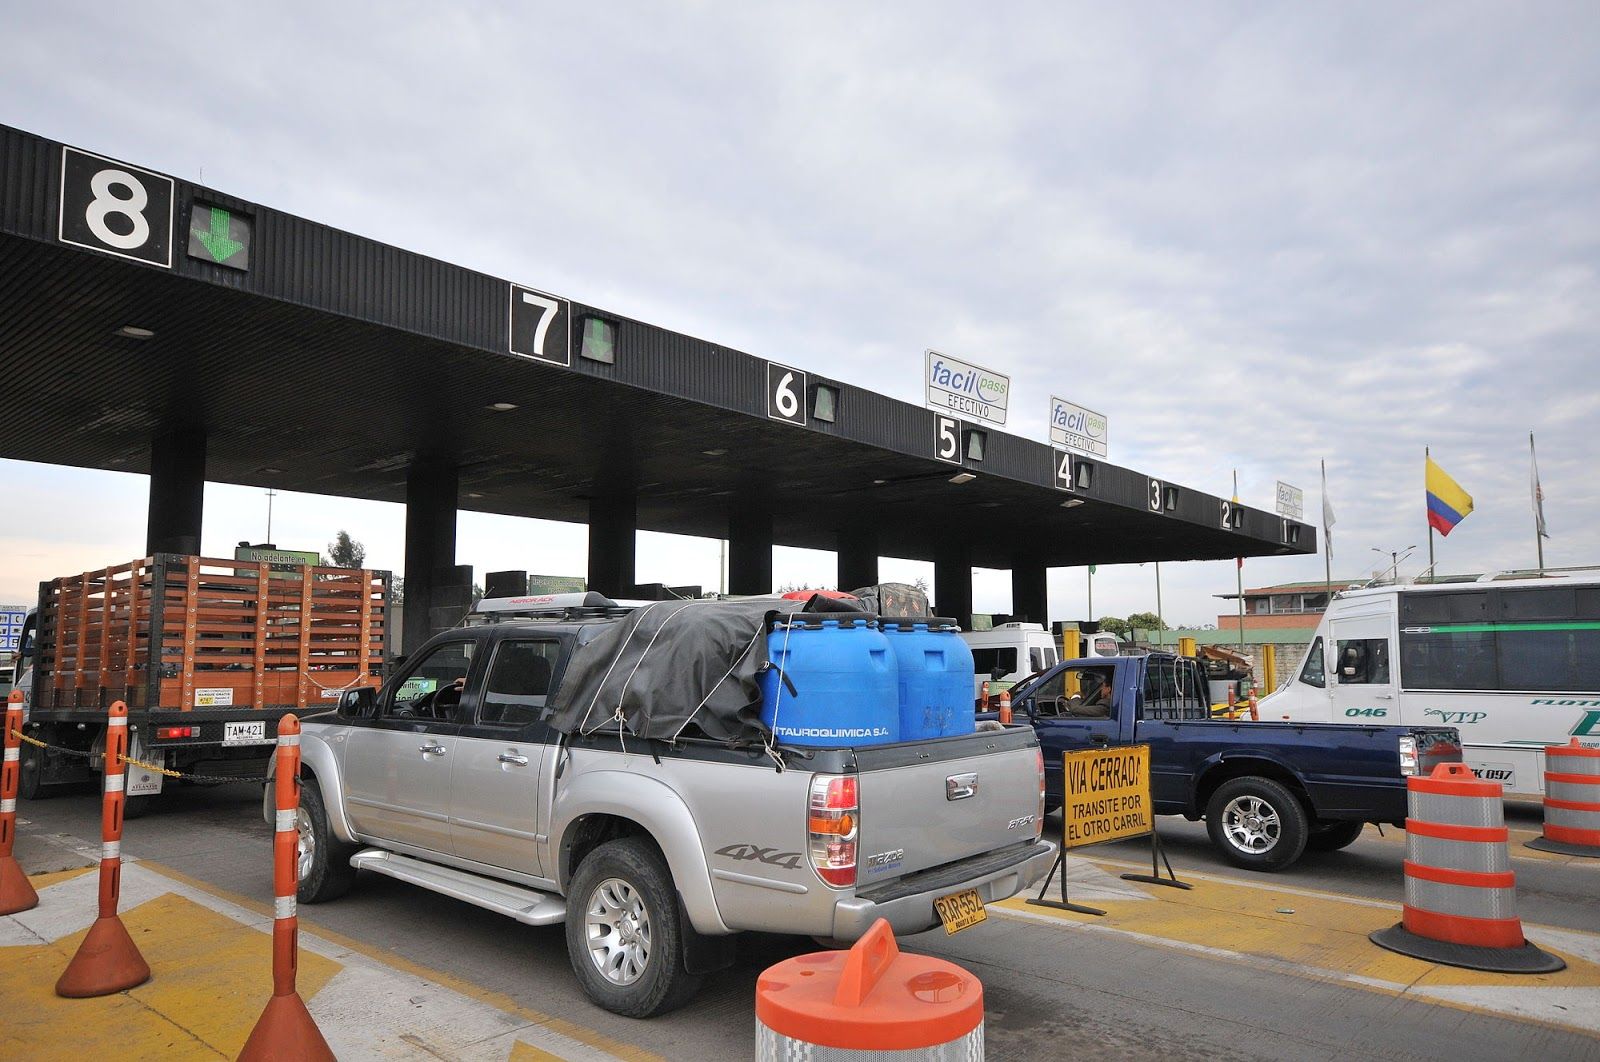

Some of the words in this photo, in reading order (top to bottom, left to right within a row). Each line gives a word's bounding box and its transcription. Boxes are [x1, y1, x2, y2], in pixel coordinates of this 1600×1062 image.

[86, 169, 149, 249] 8
[523, 292, 558, 355] 7
[932, 361, 976, 393] facil
[980, 378, 1006, 394] pass
[775, 372, 798, 417] 6
[948, 394, 989, 417] EFECTIVO
[1053, 404, 1084, 431] facil
[1087, 417, 1105, 430] pass
[940, 418, 956, 458] 5
[1065, 433, 1094, 451] EFECTIVO
[1058, 454, 1071, 488] 4
[1151, 480, 1160, 510] 3
[1222, 501, 1230, 528] 2
[1282, 516, 1287, 543] 1
[250, 551, 261, 561] No
[264, 553, 295, 563] adelante
[1345, 708, 1387, 717] 046
[1432, 710, 1487, 723] VIP
[1069, 760, 1087, 795] VIA
[1486, 769, 1512, 780] 097
[1073, 798, 1119, 819] TRANSITE
[1122, 795, 1141, 811] POR
[1069, 824, 1081, 840] EL
[1083, 819, 1110, 837] OTRO
[1114, 813, 1147, 831] CARRIL
